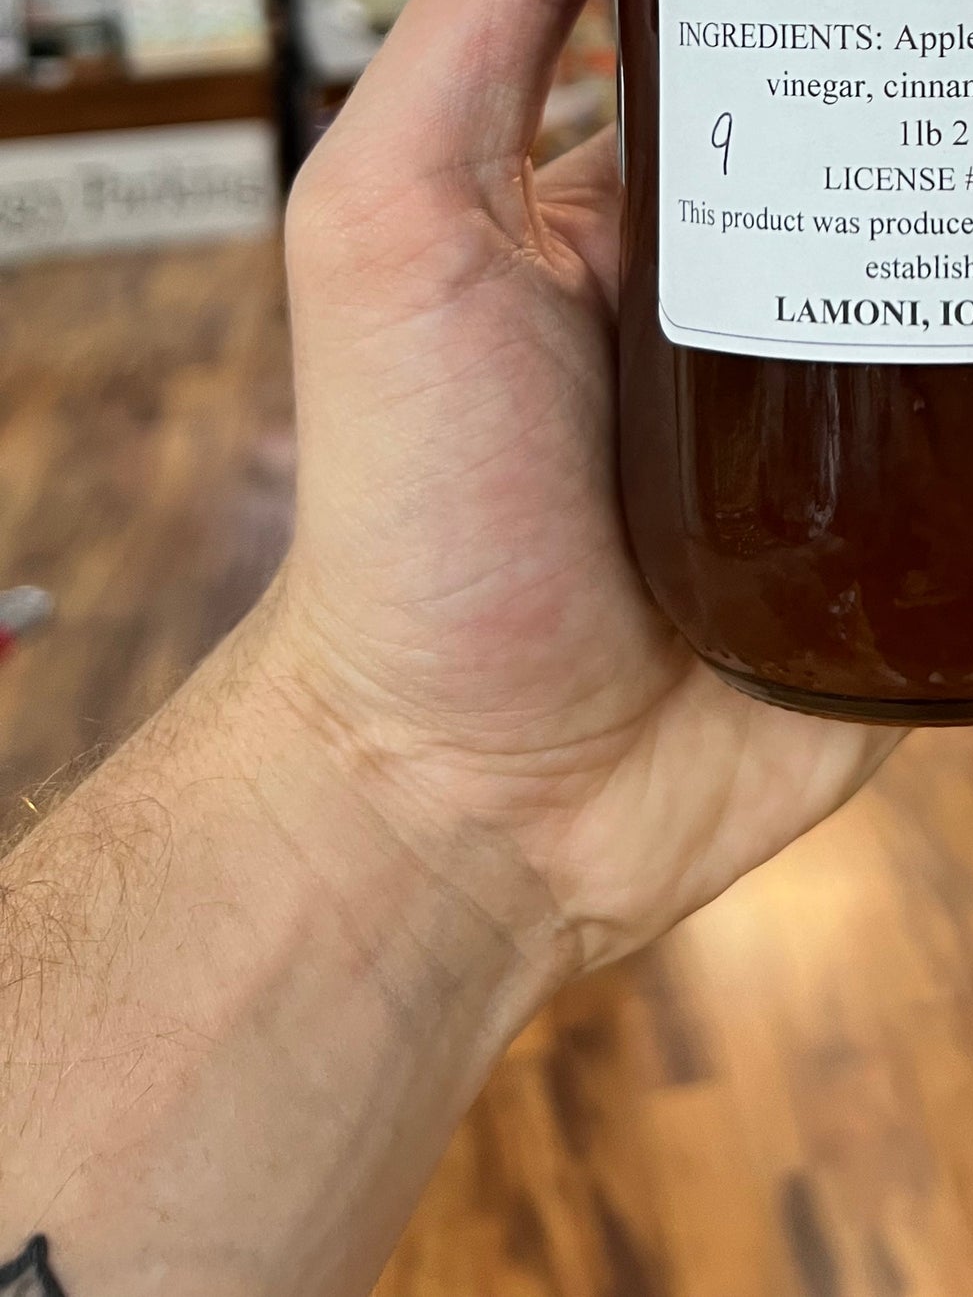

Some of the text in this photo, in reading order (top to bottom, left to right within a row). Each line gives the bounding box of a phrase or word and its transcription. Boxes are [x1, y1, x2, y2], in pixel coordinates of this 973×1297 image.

[679, 22, 881, 50] INGREDIENTS:
[767, 70, 873, 105] vinegar,
[953, 120, 968, 145] 2
[824, 167, 955, 191] LICENSE
[679, 199, 715, 225] This
[722, 206, 804, 233] product
[813, 217, 860, 234] was
[776, 296, 929, 331] LAMONI,
